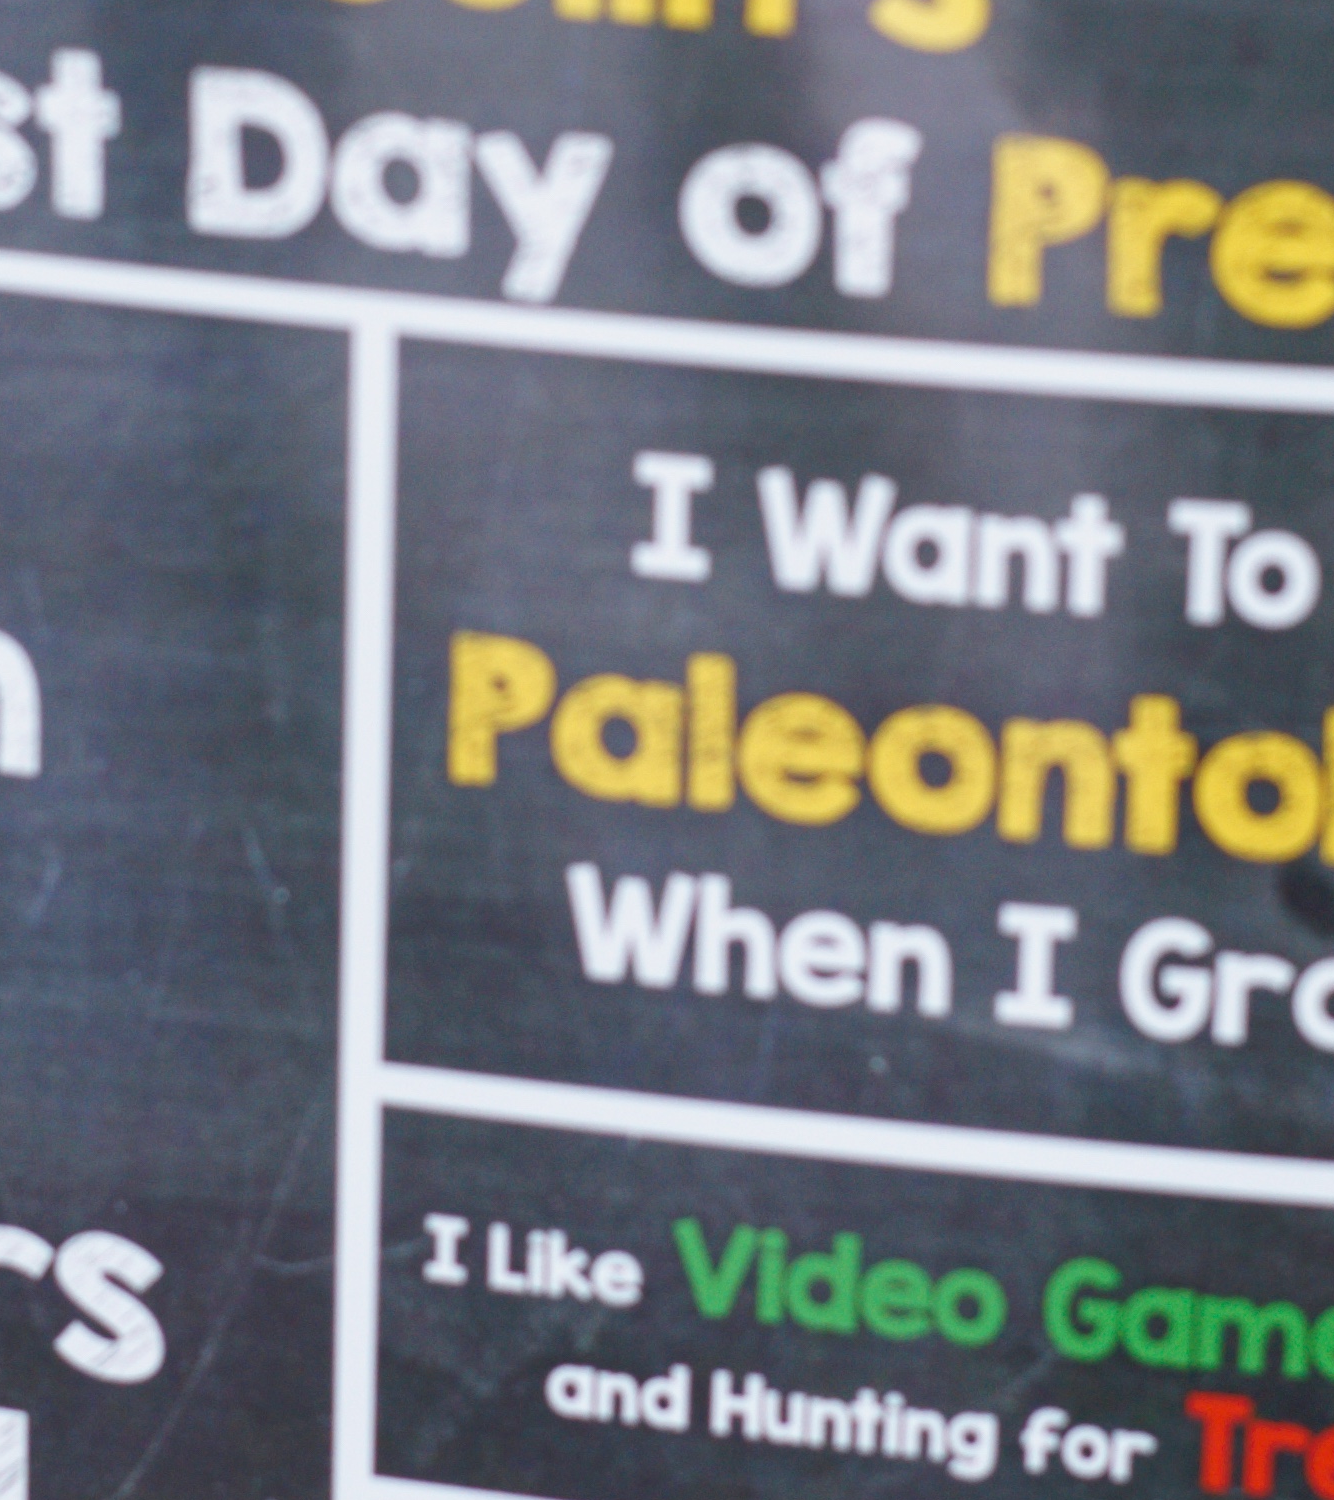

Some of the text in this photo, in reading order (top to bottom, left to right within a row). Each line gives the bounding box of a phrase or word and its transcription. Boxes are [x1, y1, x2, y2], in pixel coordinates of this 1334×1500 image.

[185, 65, 613, 302] Day
[679, 114, 924, 298] of
[630, 450, 714, 582] I
[757, 466, 1125, 618] Want
[1166, 497, 1320, 629] To
[565, 861, 953, 1018] When
[993, 901, 1078, 1031] I
[422, 1212, 470, 1285] I
[486, 1221, 644, 1307] Like
[673, 1218, 1006, 1346] Video
[544, 1362, 692, 1432] and
[708, 1368, 999, 1482] Hunting
[1018, 1405, 1157, 1483] for
